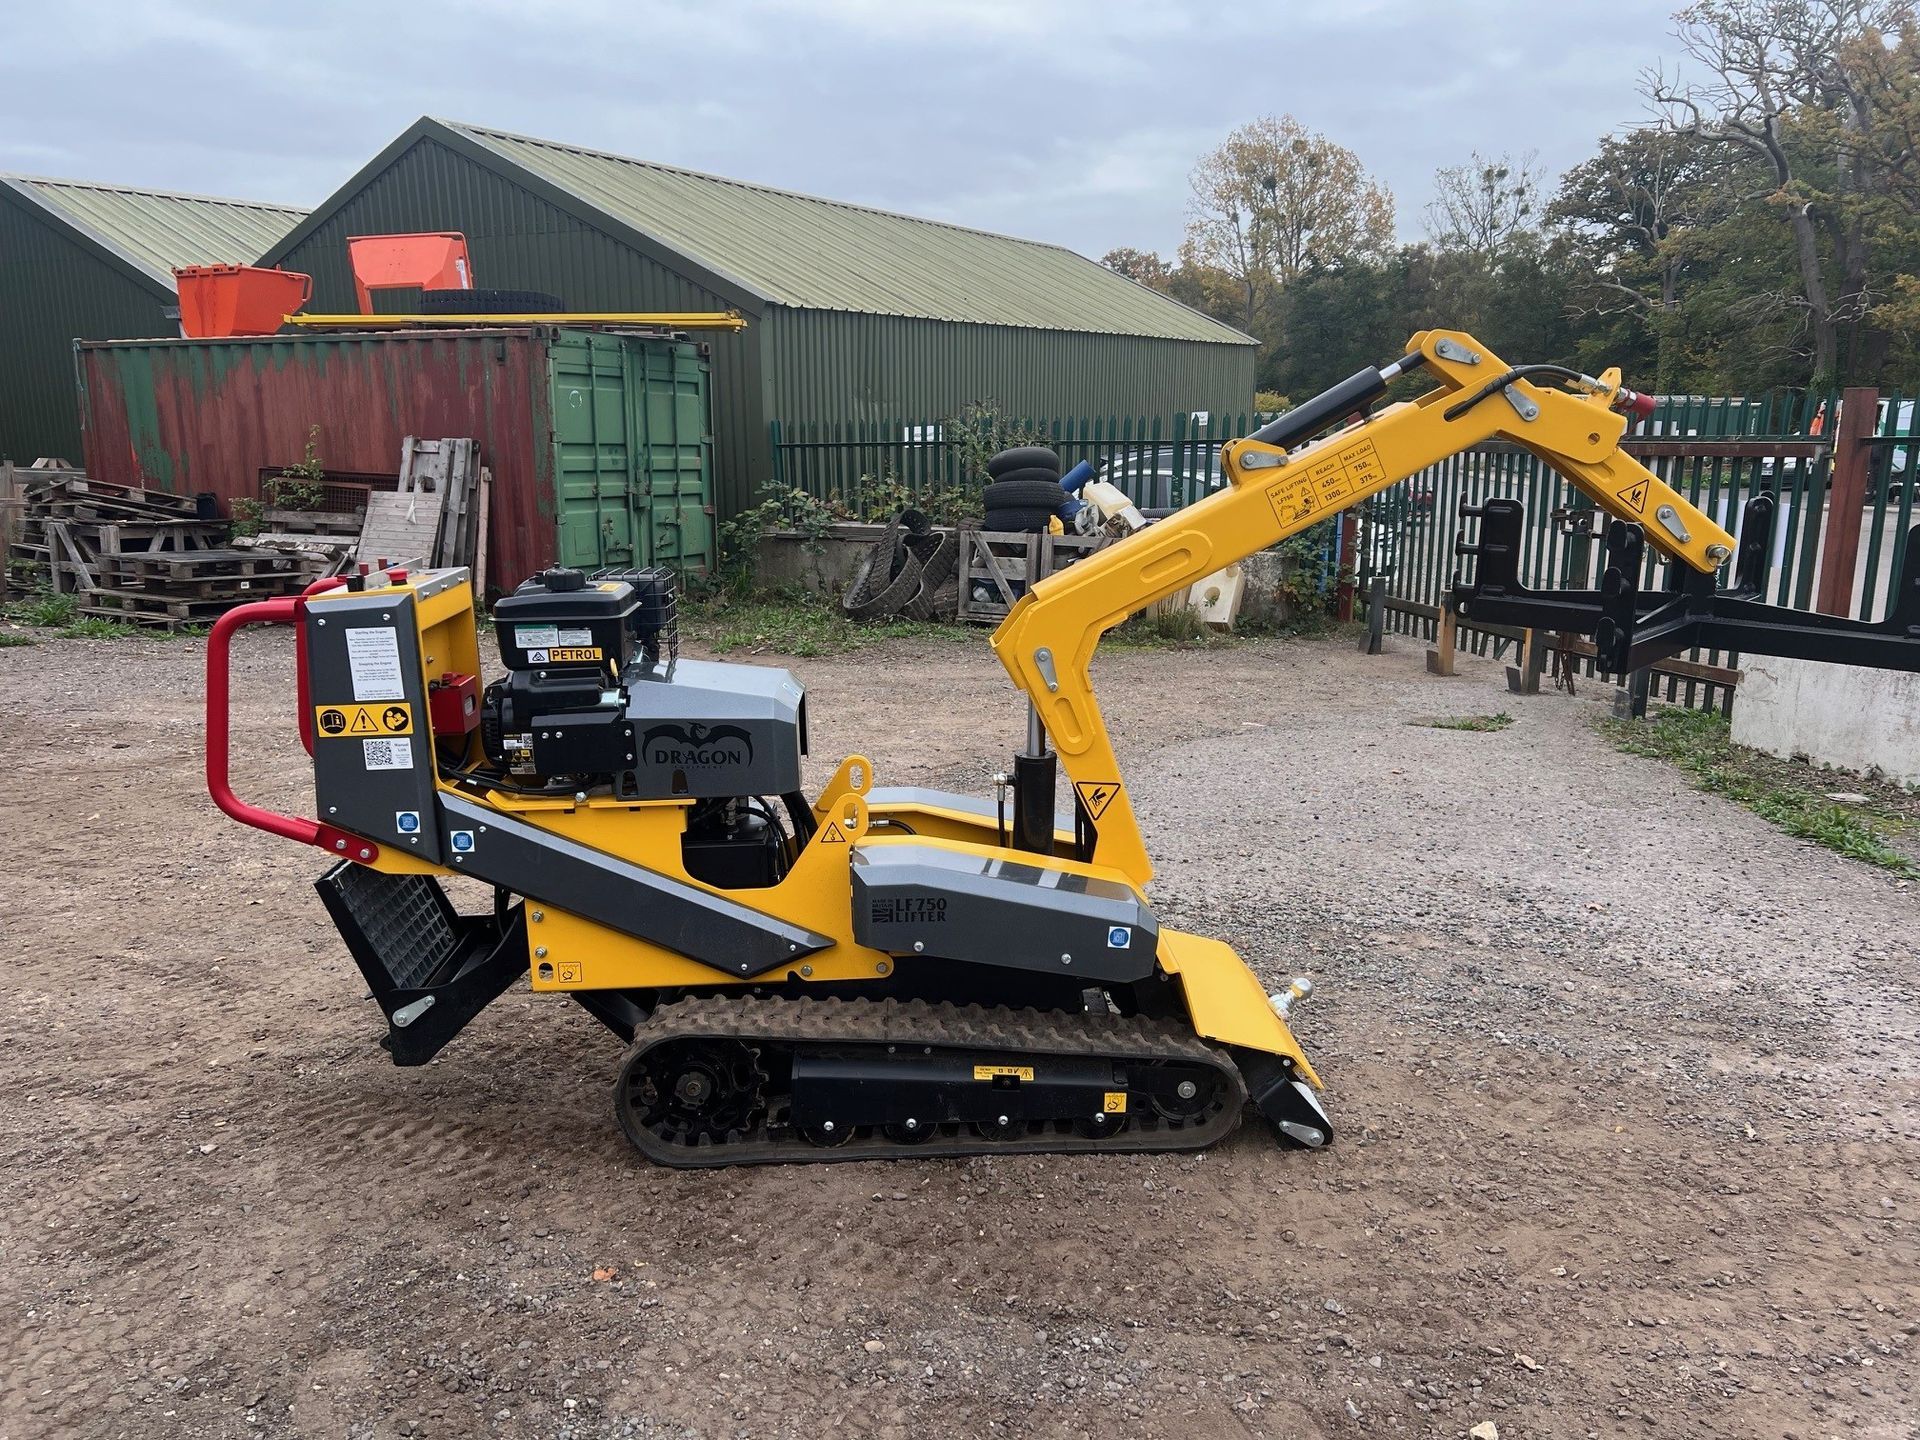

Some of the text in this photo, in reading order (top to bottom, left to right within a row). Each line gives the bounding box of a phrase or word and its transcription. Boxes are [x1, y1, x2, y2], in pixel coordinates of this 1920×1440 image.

[1343, 444, 1372, 462] MAX LOAD
[1315, 463, 1335, 476] REACH
[1270, 476, 1308, 499] SAFE LIFTING
[552, 649, 600, 660] PETROL
[655, 750, 741, 764] DRAGON
[895, 898, 947, 911] LF750
[895, 911, 946, 923] LIFTER
